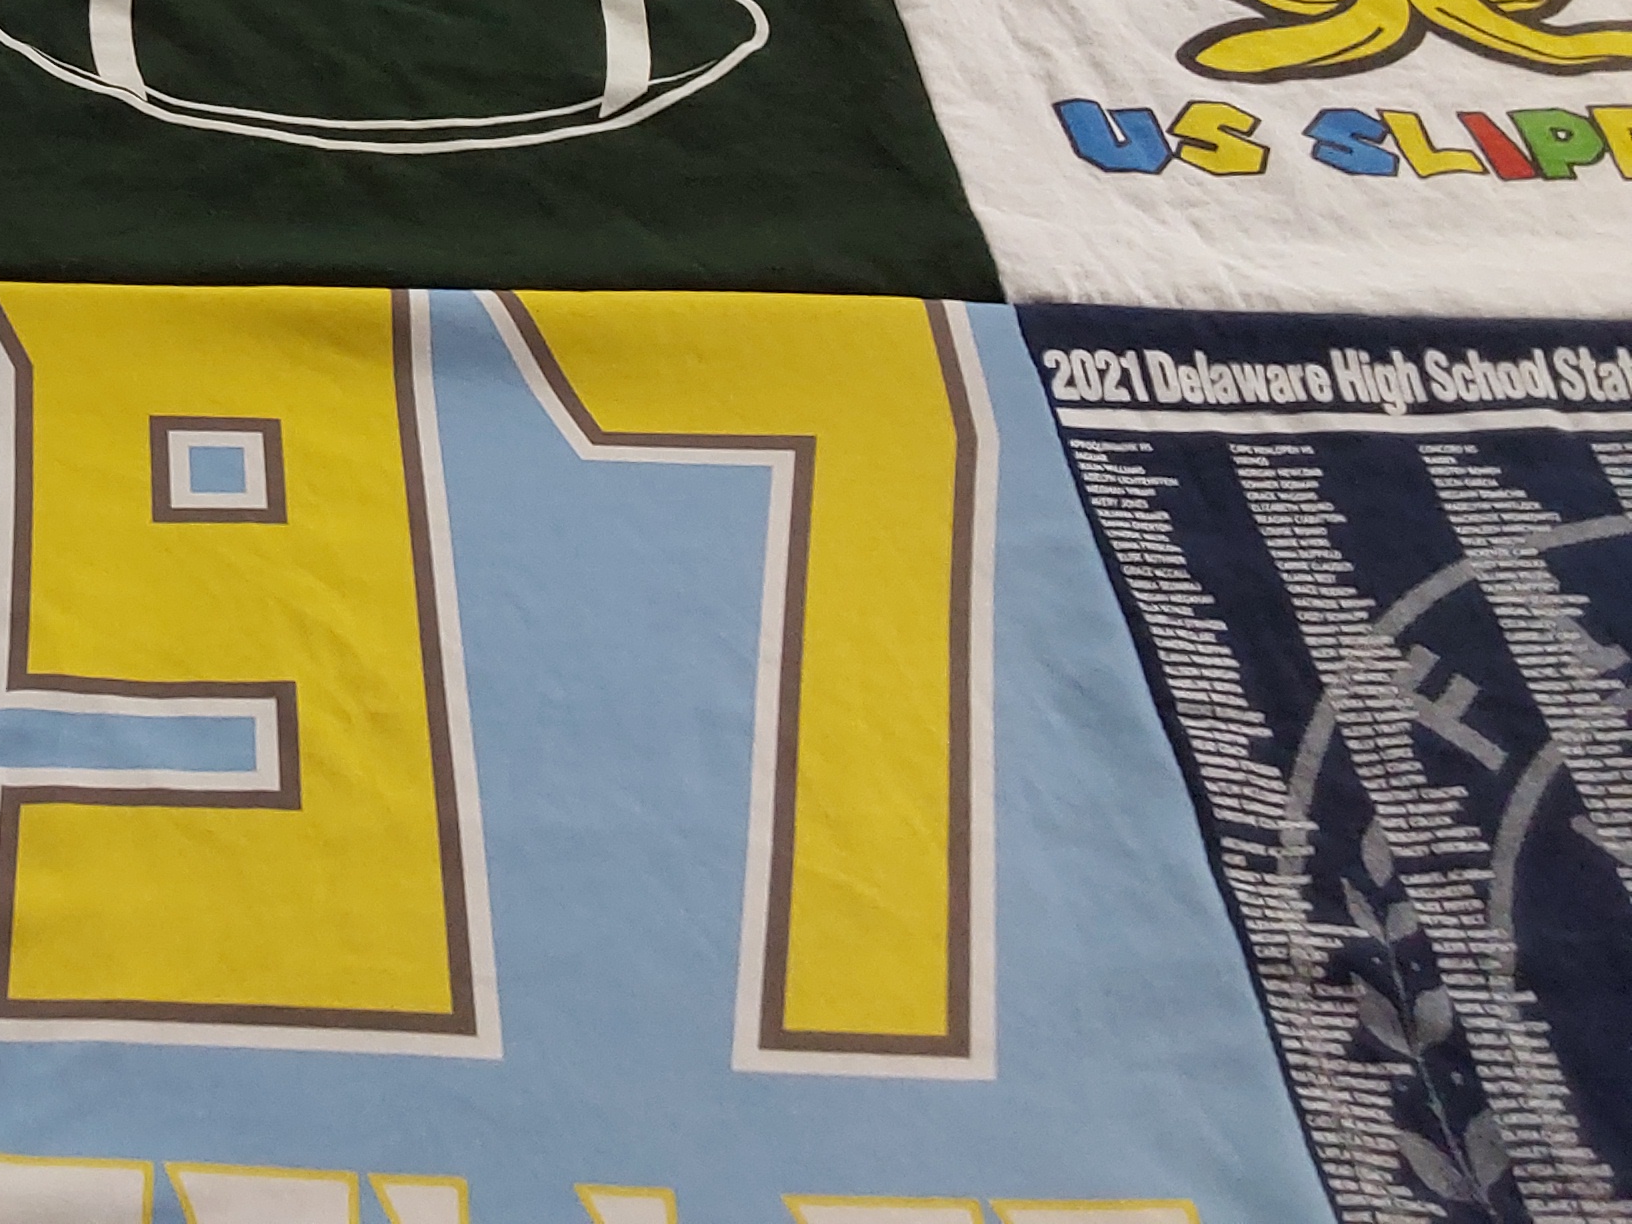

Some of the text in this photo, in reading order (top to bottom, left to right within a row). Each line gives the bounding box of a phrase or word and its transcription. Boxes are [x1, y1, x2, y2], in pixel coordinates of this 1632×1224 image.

[1053, 98, 1270, 176] US
[1043, 349, 1149, 404] 2021
[1144, 349, 1331, 405] Delaware
[1329, 347, 1428, 415] High
[1424, 347, 1559, 403] School
